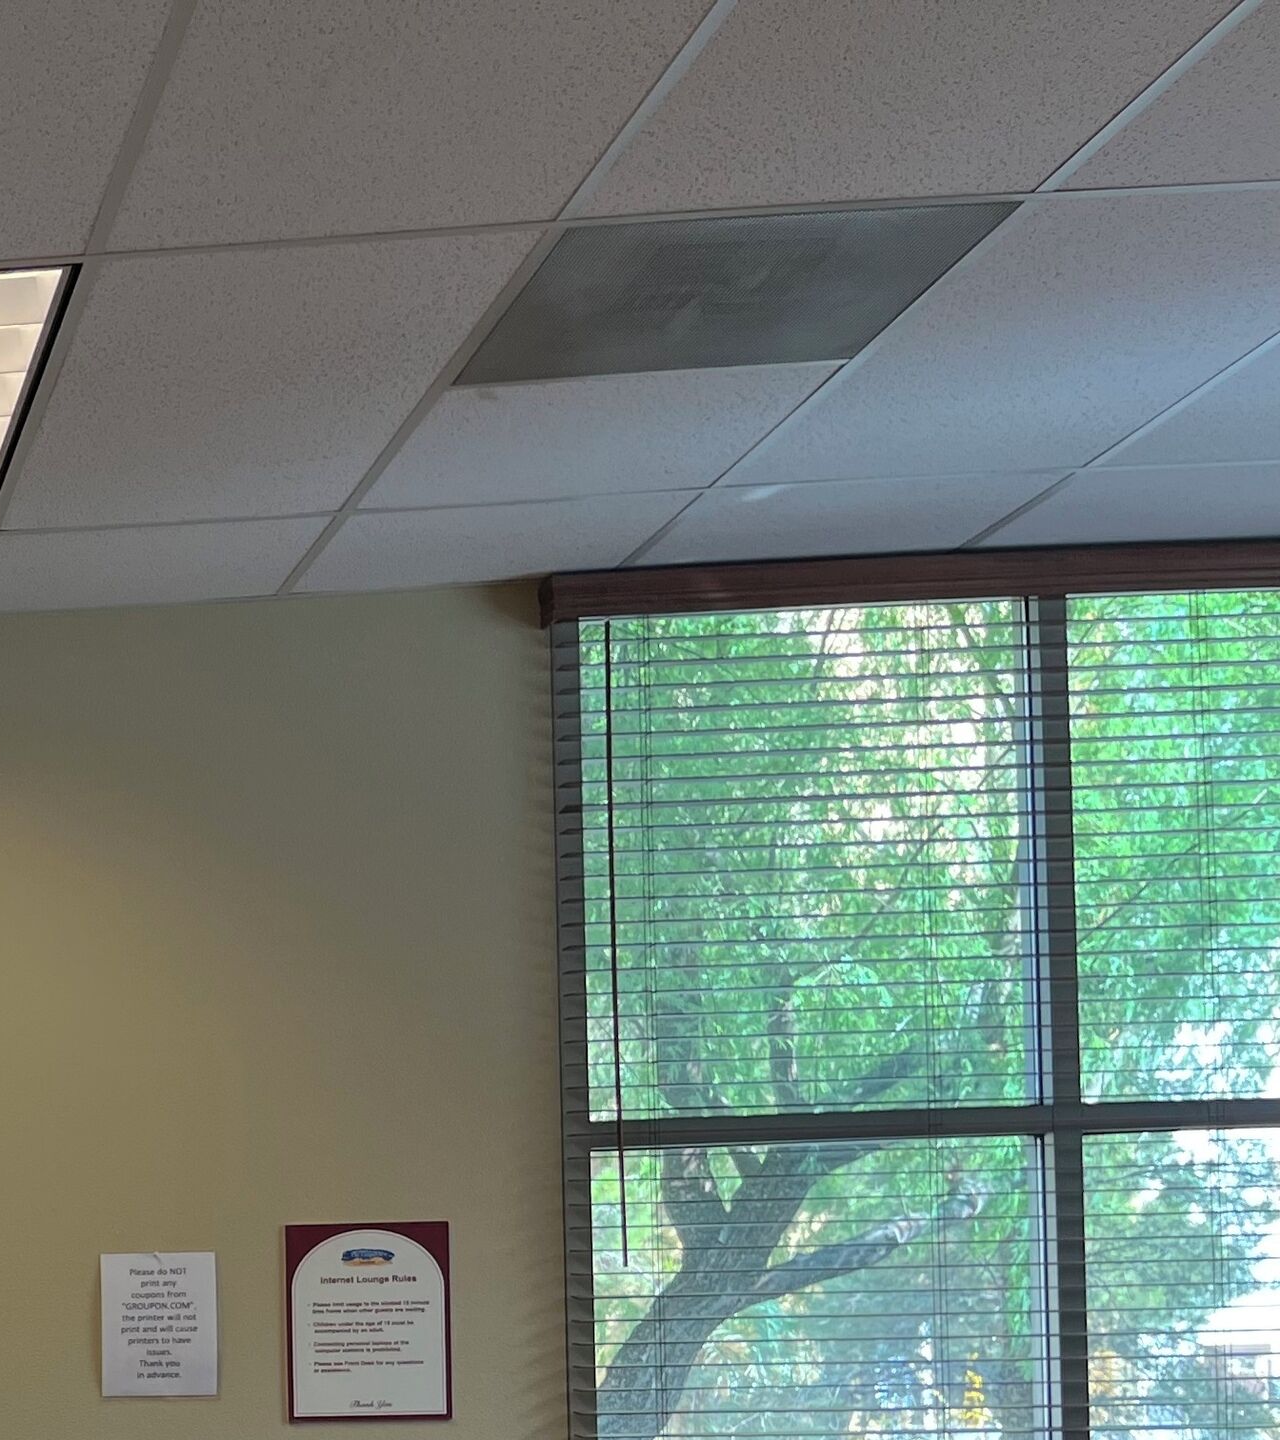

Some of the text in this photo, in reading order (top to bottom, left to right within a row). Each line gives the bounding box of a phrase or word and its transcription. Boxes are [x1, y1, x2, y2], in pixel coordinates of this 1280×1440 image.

[141, 1280, 160, 1288] print
[356, 1276, 389, 1284] Lounge
[128, 1338, 159, 1346] printers
